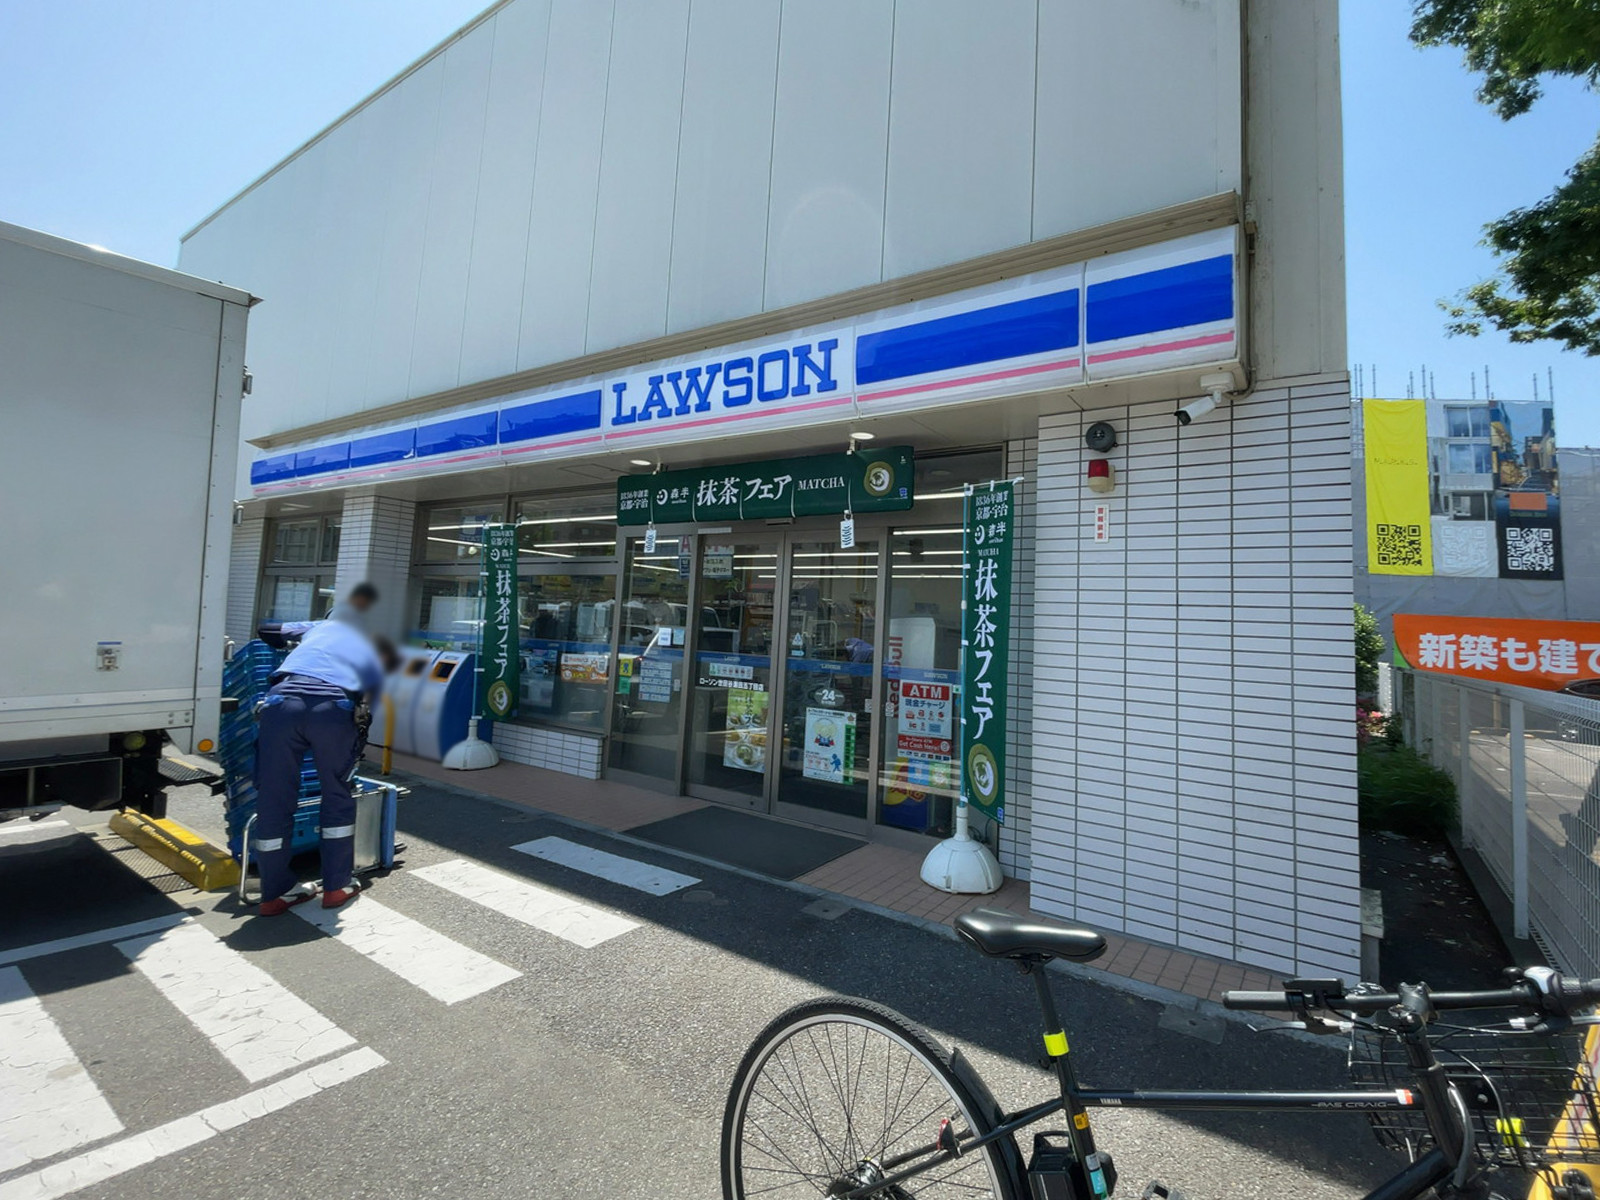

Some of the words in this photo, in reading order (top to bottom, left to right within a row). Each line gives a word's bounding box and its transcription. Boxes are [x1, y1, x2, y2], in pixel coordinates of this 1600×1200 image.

[611, 338, 838, 426] LAWSON
[696, 474, 792, 506] 抹茶フェア
[797, 476, 845, 491] MATCHA
[494, 570, 512, 679] 抹茶フェア
[972, 558, 999, 739] 抹茶フェア
[822, 689, 835, 701] 24
[905, 698, 946, 709] 現金チャージ
[909, 684, 942, 699] ATM
